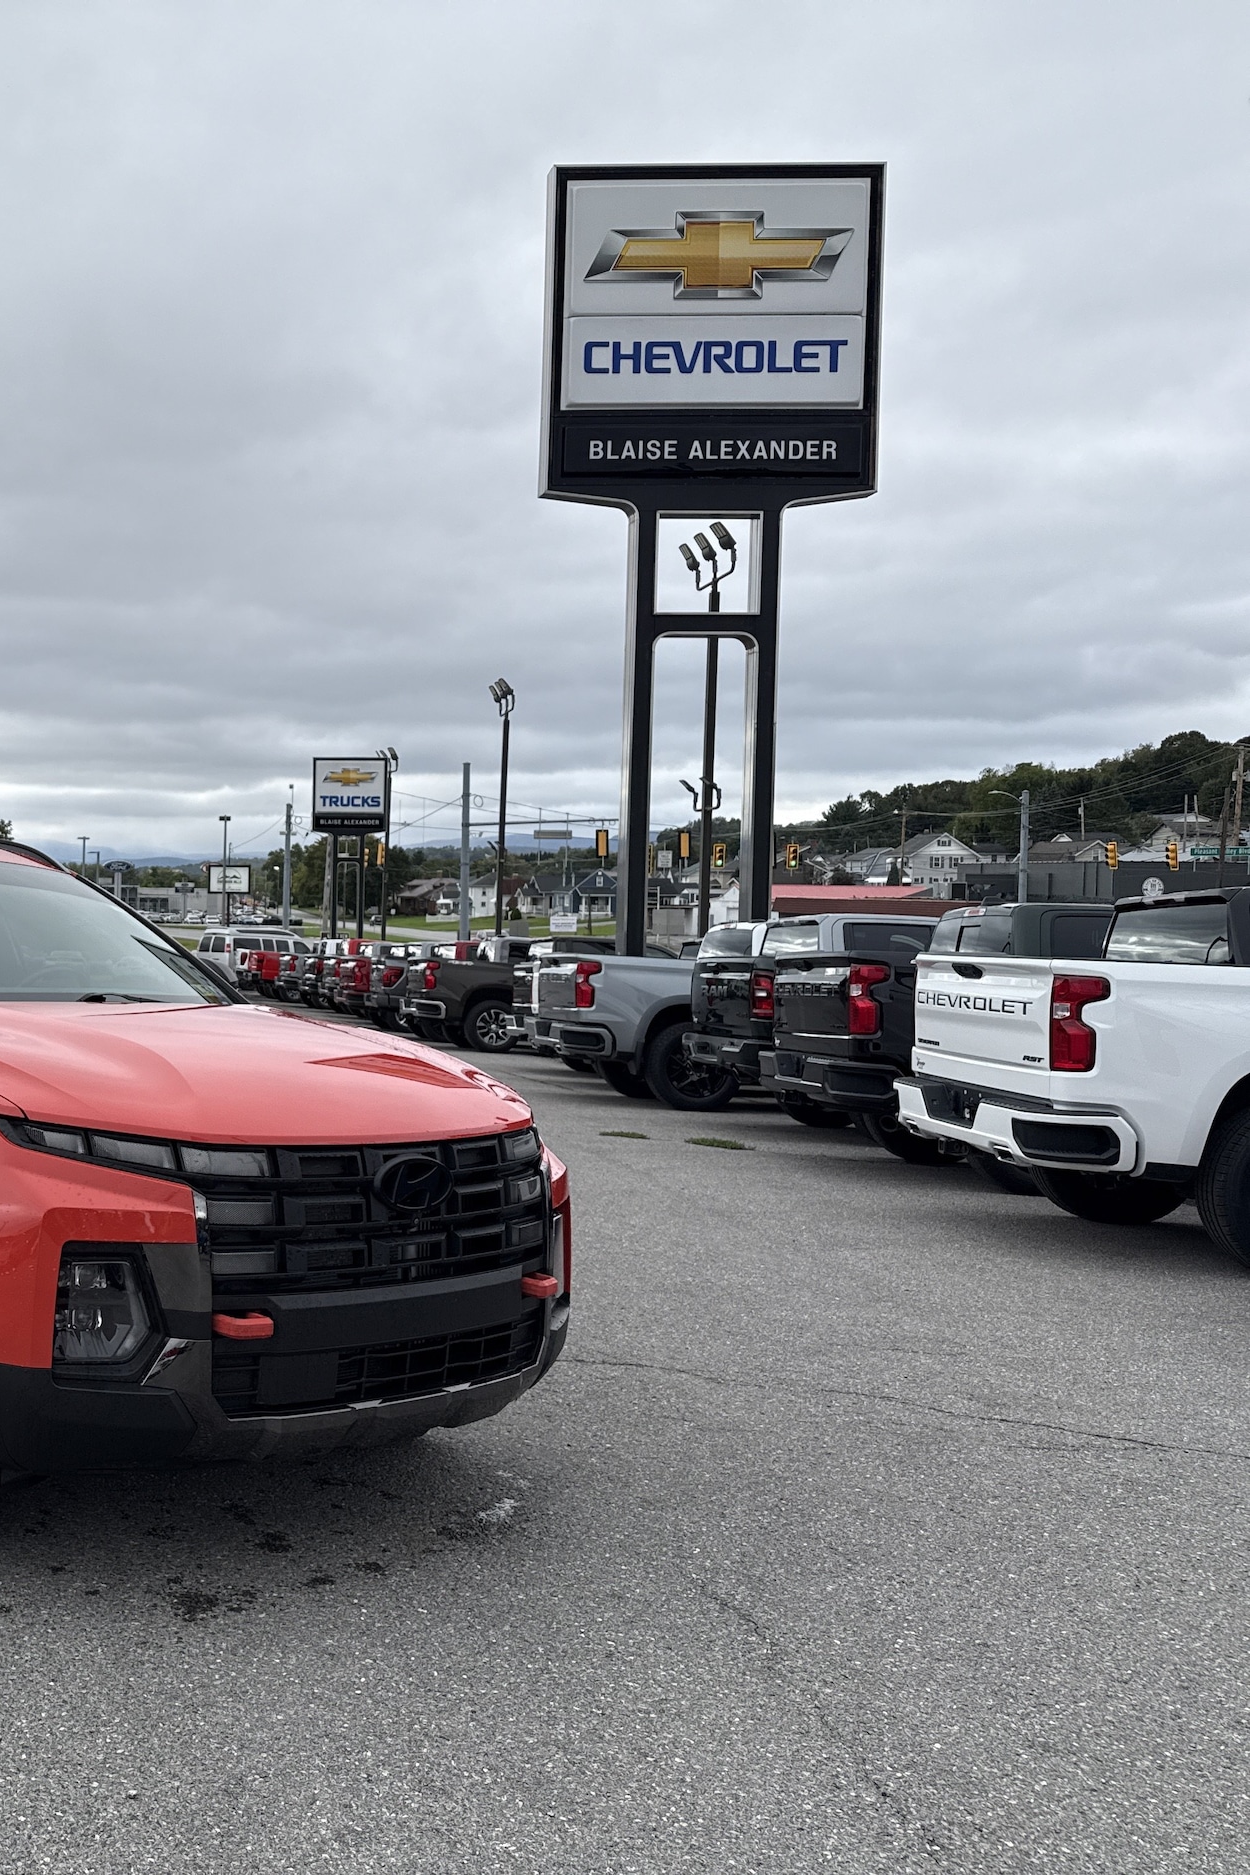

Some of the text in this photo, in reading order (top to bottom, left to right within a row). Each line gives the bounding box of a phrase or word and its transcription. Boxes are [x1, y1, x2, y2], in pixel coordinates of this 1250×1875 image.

[583, 339, 848, 374] CHEVROLET
[588, 440, 837, 460] BLAISE ALEXANDER
[319, 795, 381, 807] TRUCKS
[109, 862, 127, 871] Ford
[701, 985, 728, 997] RAM
[917, 991, 1033, 1015] CHEVROLET
[1022, 1055, 1045, 1063] RST
